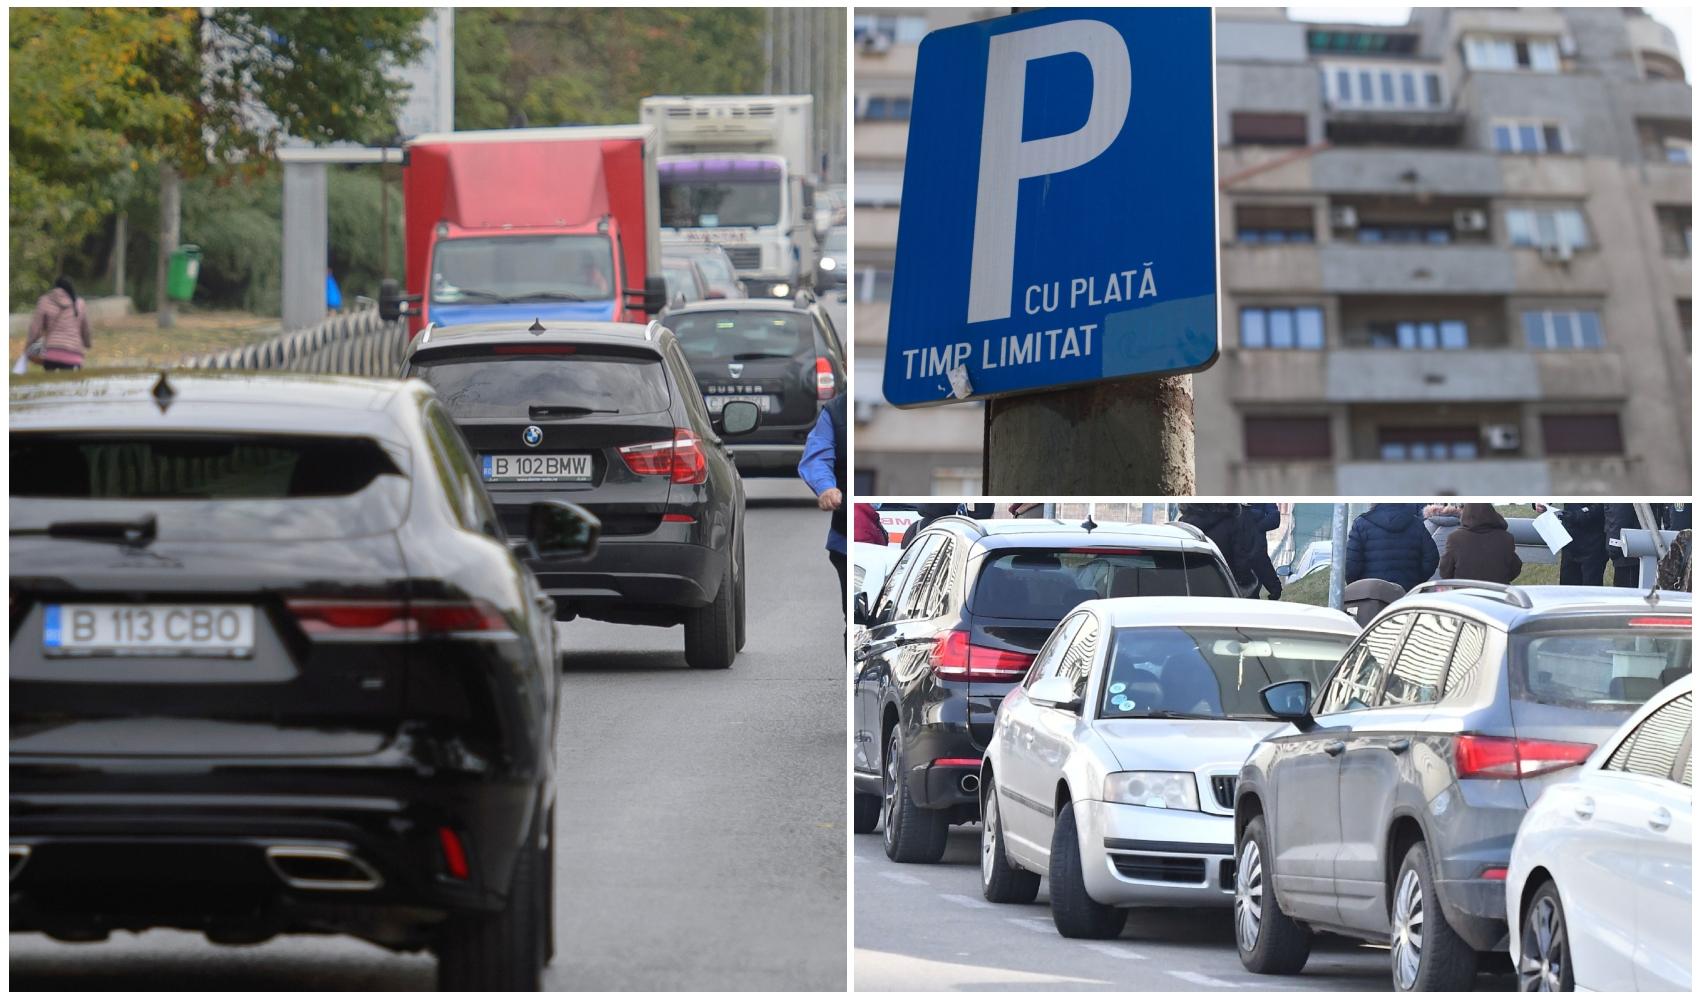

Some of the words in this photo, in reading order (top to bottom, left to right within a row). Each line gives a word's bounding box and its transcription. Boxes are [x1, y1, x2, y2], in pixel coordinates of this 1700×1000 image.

[967, 19, 1132, 324] P
[1025, 281, 1060, 315] CU
[1070, 261, 1158, 310] PLATĂ
[902, 341, 972, 380] TIMP
[981, 323, 1098, 371] LIMITAT
[496, 457, 509, 475] B
[515, 457, 543, 475] 102
[546, 457, 587, 475] BMW
[73, 609, 96, 642] B
[111, 608, 155, 642] 113
[164, 609, 240, 642] CBO
